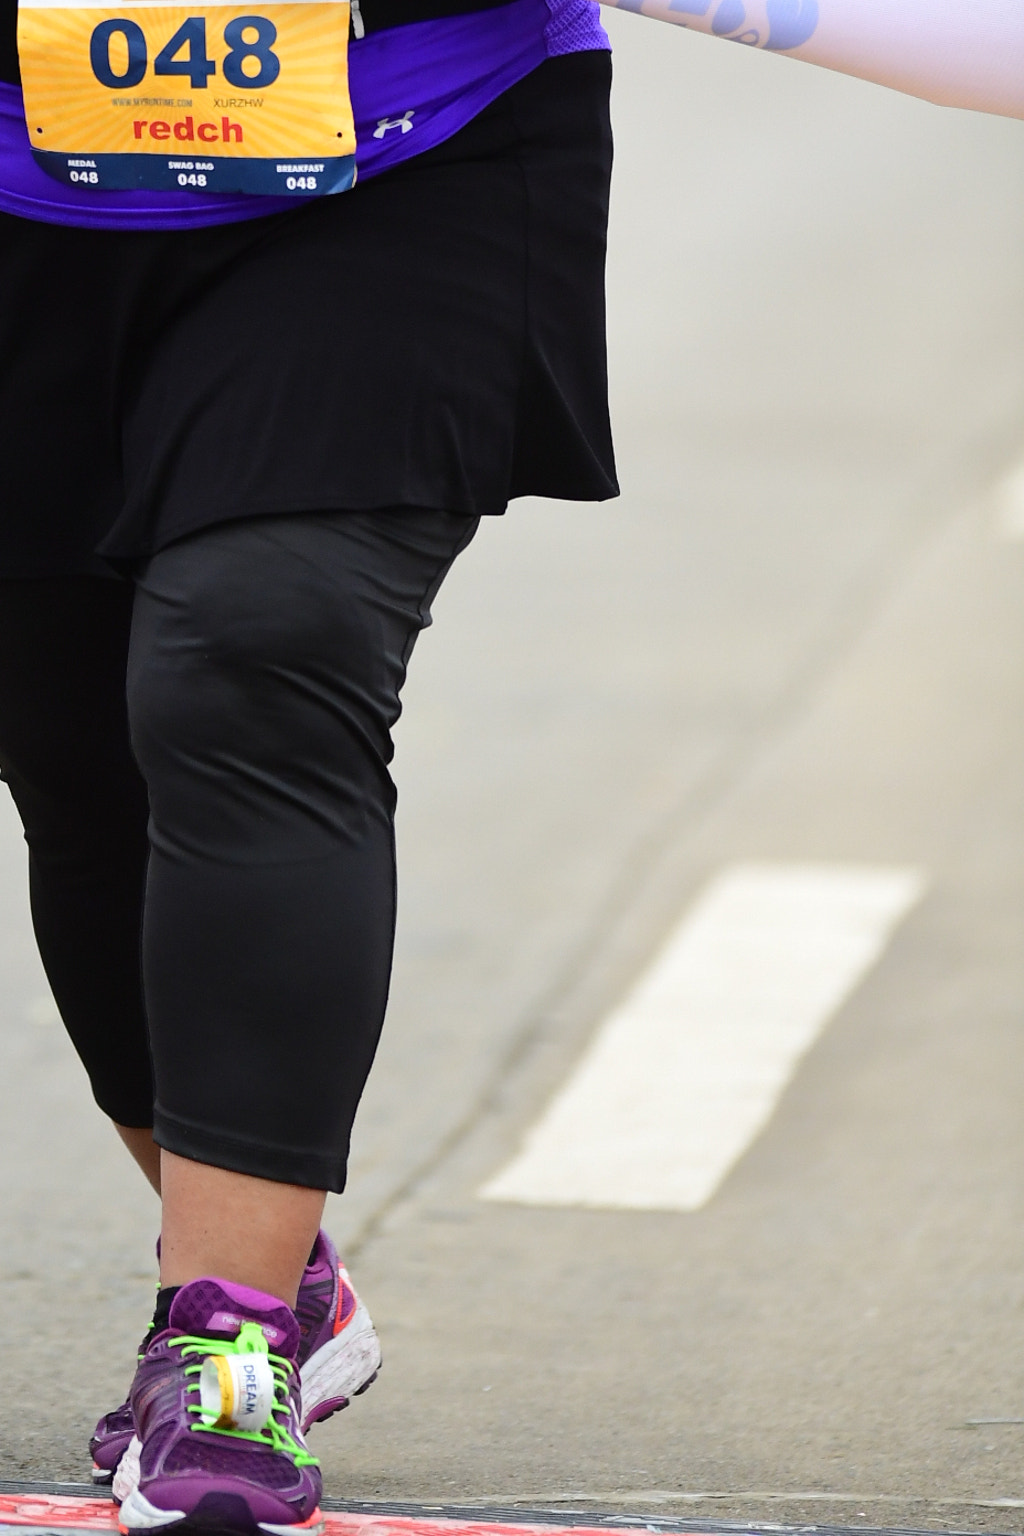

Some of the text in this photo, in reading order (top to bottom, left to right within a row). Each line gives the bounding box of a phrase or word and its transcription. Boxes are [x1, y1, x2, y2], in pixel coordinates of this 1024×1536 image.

[89, 15, 281, 90] 048
[213, 98, 264, 108] XURZHW
[133, 116, 244, 143] redch
[67, 159, 97, 168] MEDAL
[168, 161, 214, 171] SWAG BAG
[276, 164, 325, 173] BREAKFAST
[70, 171, 99, 184] 048
[177, 173, 208, 187] 048
[286, 176, 318, 190] 048
[243, 1364, 257, 1416] DREAM
